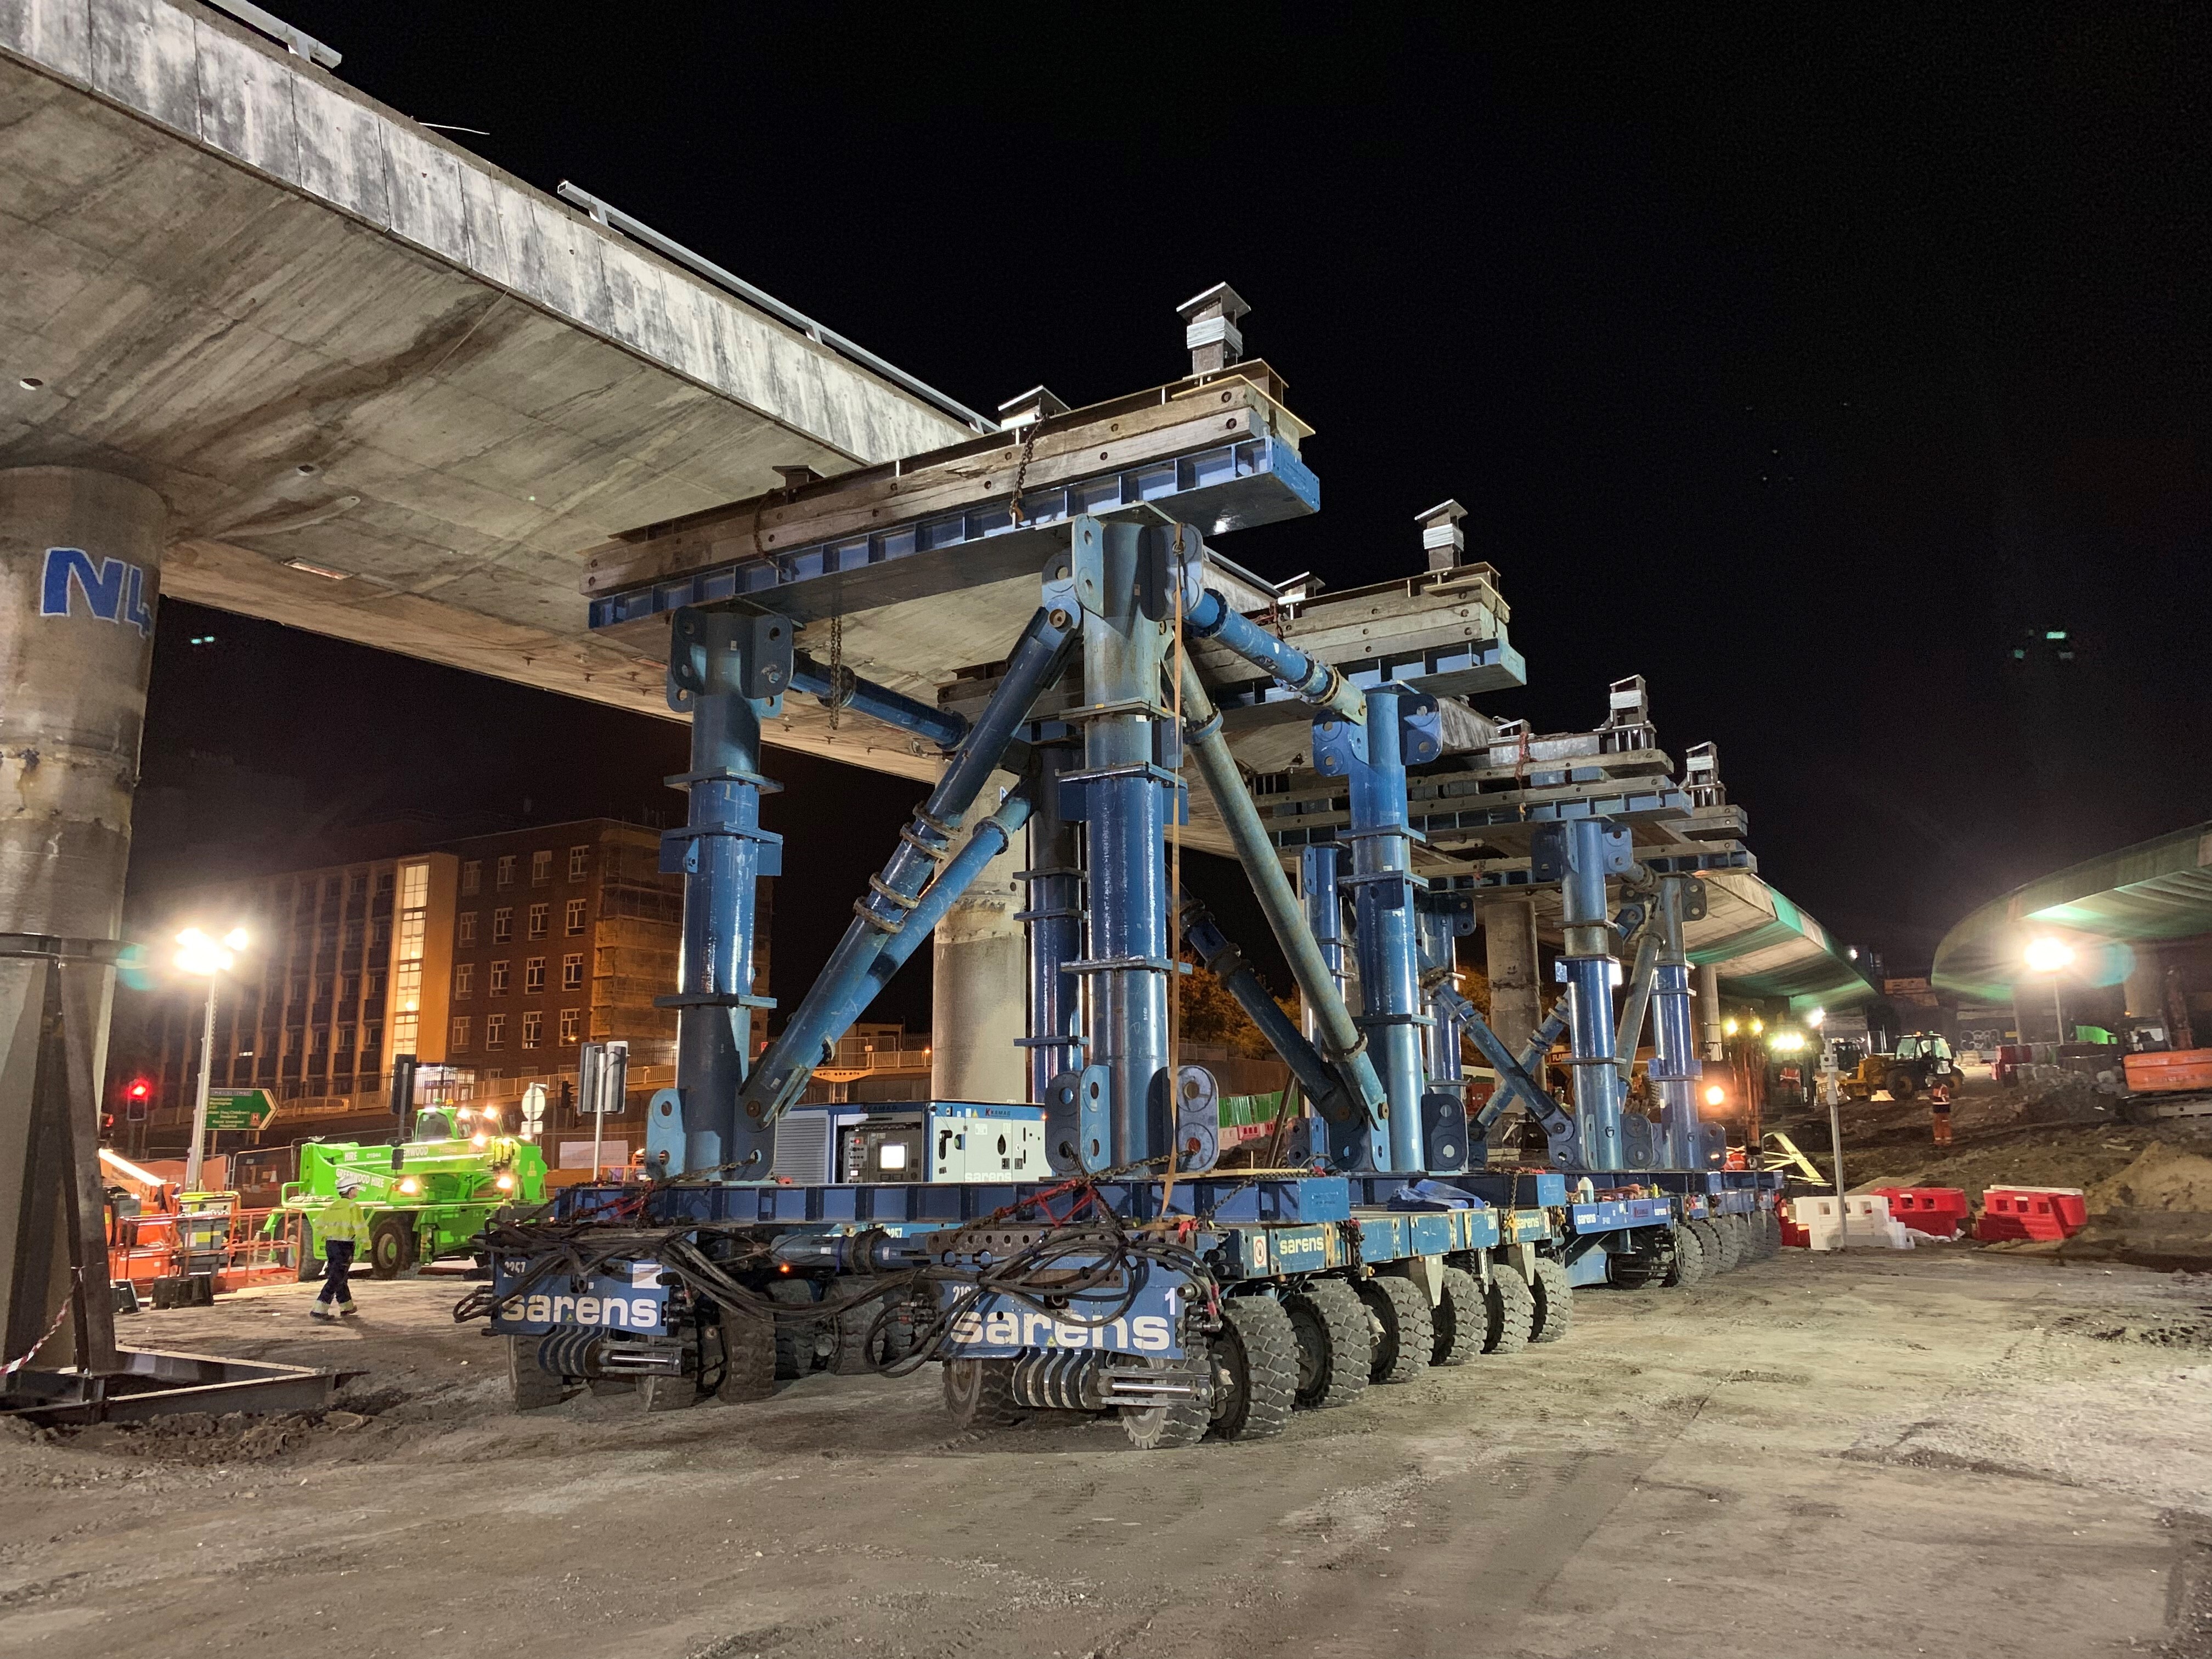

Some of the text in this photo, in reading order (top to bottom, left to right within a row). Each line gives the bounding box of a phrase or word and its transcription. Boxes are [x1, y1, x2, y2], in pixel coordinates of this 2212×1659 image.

[345, 1151, 358, 1162] HIRE
[403, 1146, 428, 1157] ENWOOD
[370, 1176, 385, 1188] HIRE
[964, 1172, 1012, 1182] sarens
[1516, 1216, 1539, 1229] sarens
[1577, 1214, 1596, 1225] sarens
[1279, 1236, 1324, 1255] sarens
[1164, 1287, 1176, 1316] 1
[501, 1294, 658, 1328] sarens
[950, 1311, 1170, 1351] sarens
